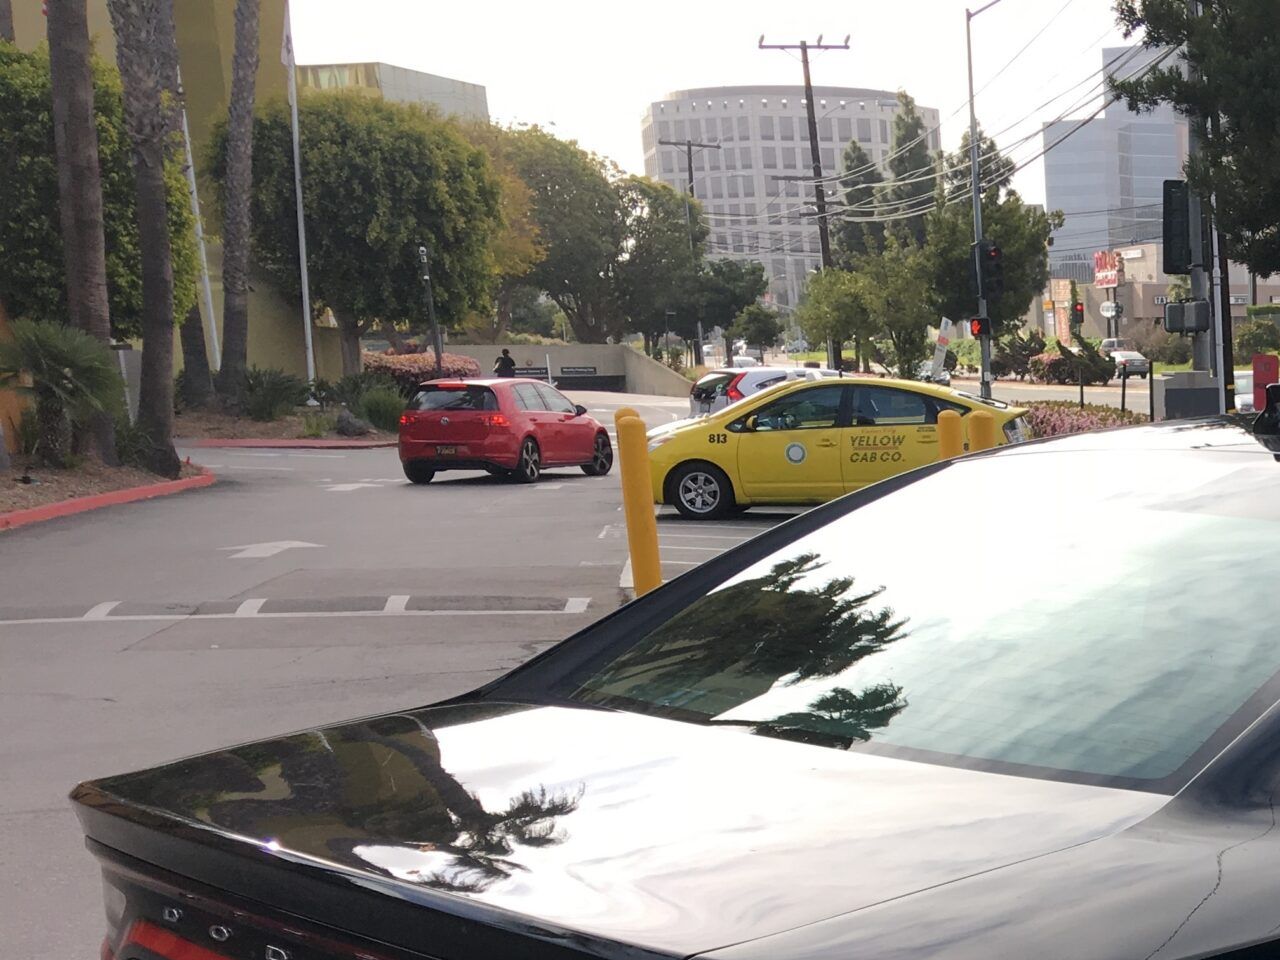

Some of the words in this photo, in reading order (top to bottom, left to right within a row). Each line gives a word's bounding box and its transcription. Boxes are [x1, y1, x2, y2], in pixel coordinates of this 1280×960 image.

[708, 433, 728, 444] 813
[850, 435, 906, 447] YELLOW
[850, 452, 878, 463] CAB
[880, 451, 906, 462] CO.
